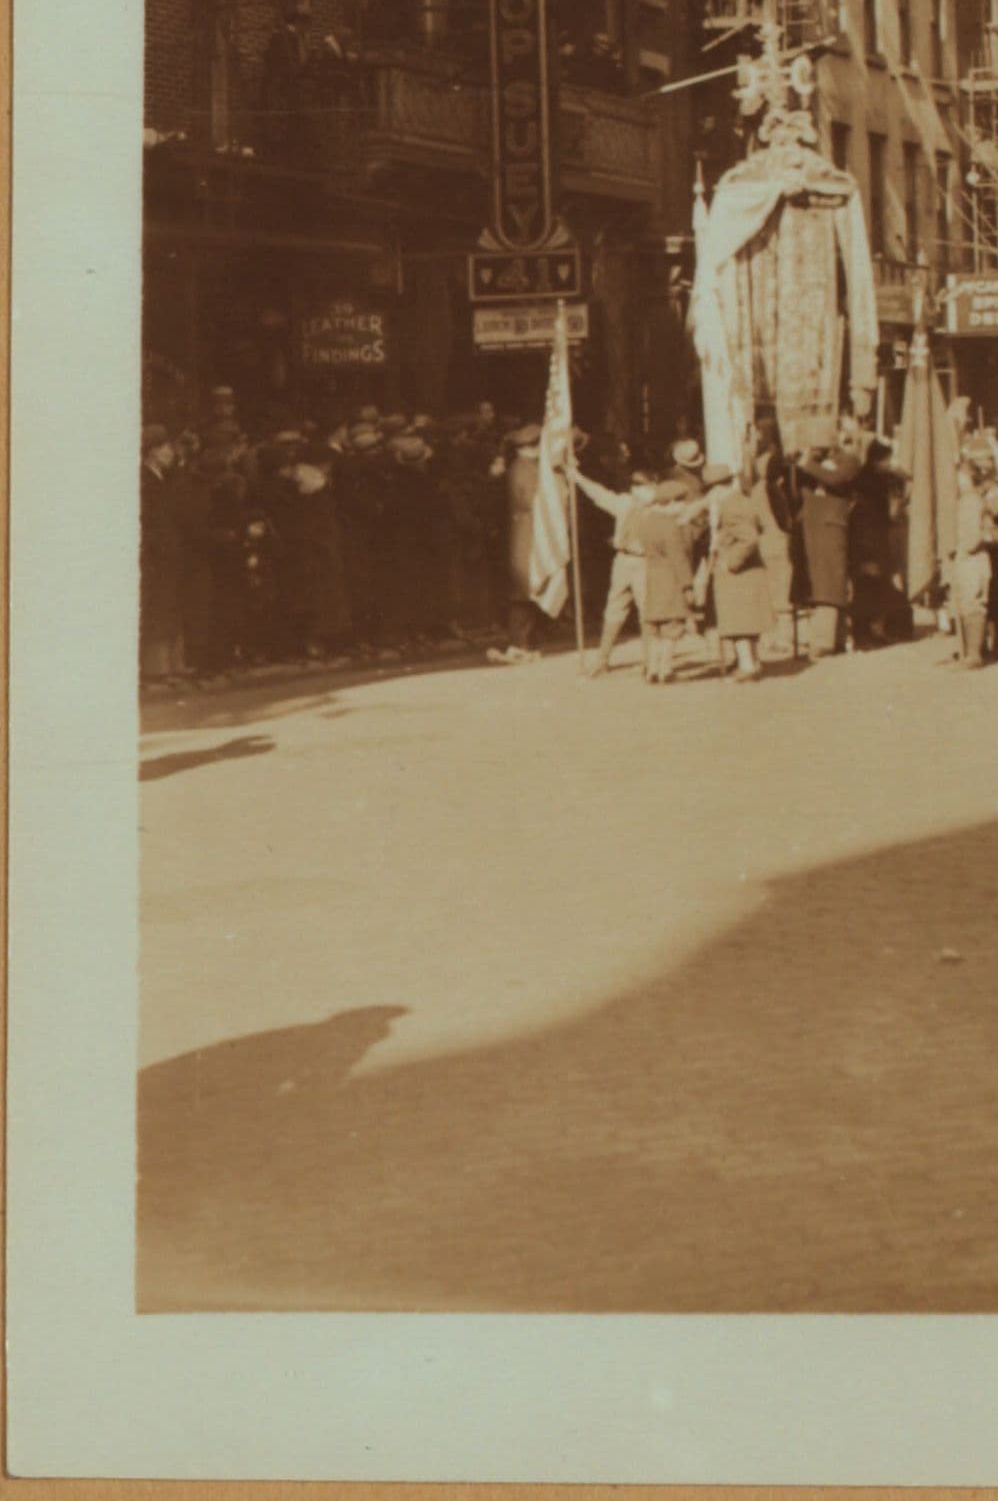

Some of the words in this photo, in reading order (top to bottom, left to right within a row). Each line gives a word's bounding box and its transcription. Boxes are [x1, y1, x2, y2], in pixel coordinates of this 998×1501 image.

[503, 81, 539, 242] SUEY
[495, 257, 552, 293] 41
[302, 314, 383, 339] LEATHER
[302, 339, 385, 365] FINDINGS
